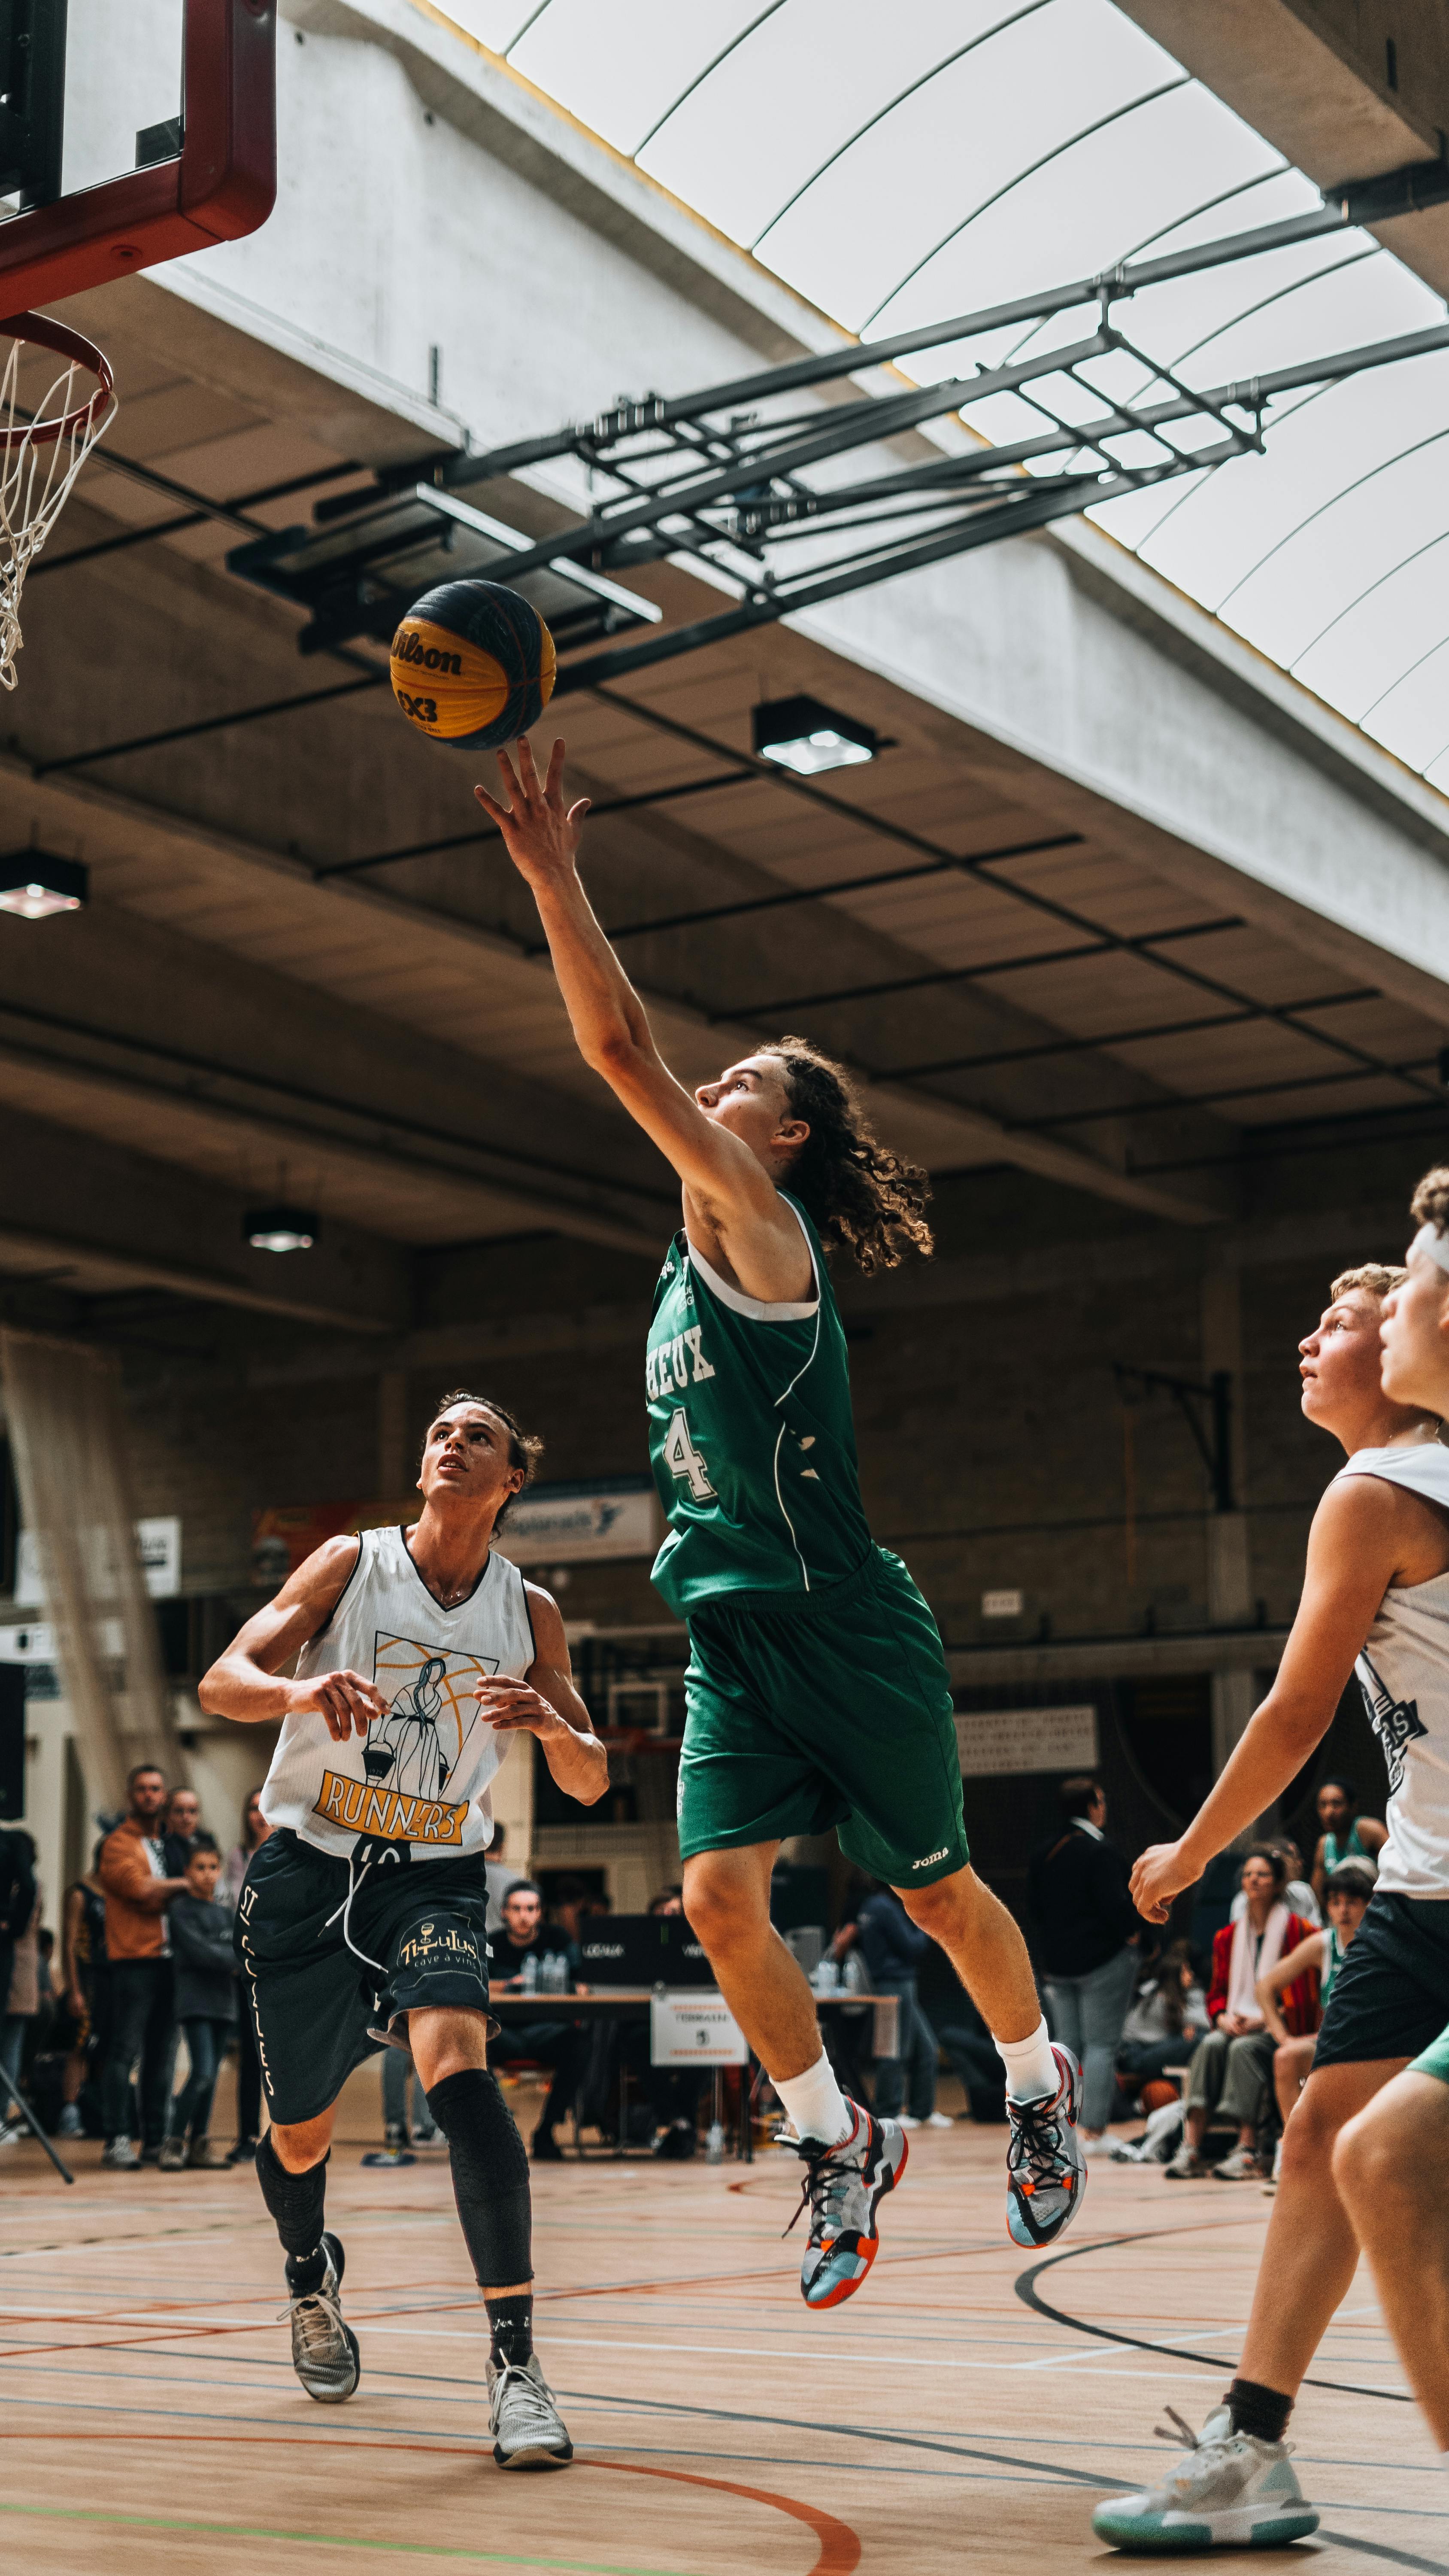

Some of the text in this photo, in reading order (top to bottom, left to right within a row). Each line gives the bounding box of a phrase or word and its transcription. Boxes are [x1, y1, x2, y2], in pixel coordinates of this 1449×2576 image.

[646, 1324, 715, 1402] HEUX
[663, 1406, 718, 1502] 4
[324, 1775, 458, 1840] RUNNERS
[415, 1955, 439, 1967] cave
